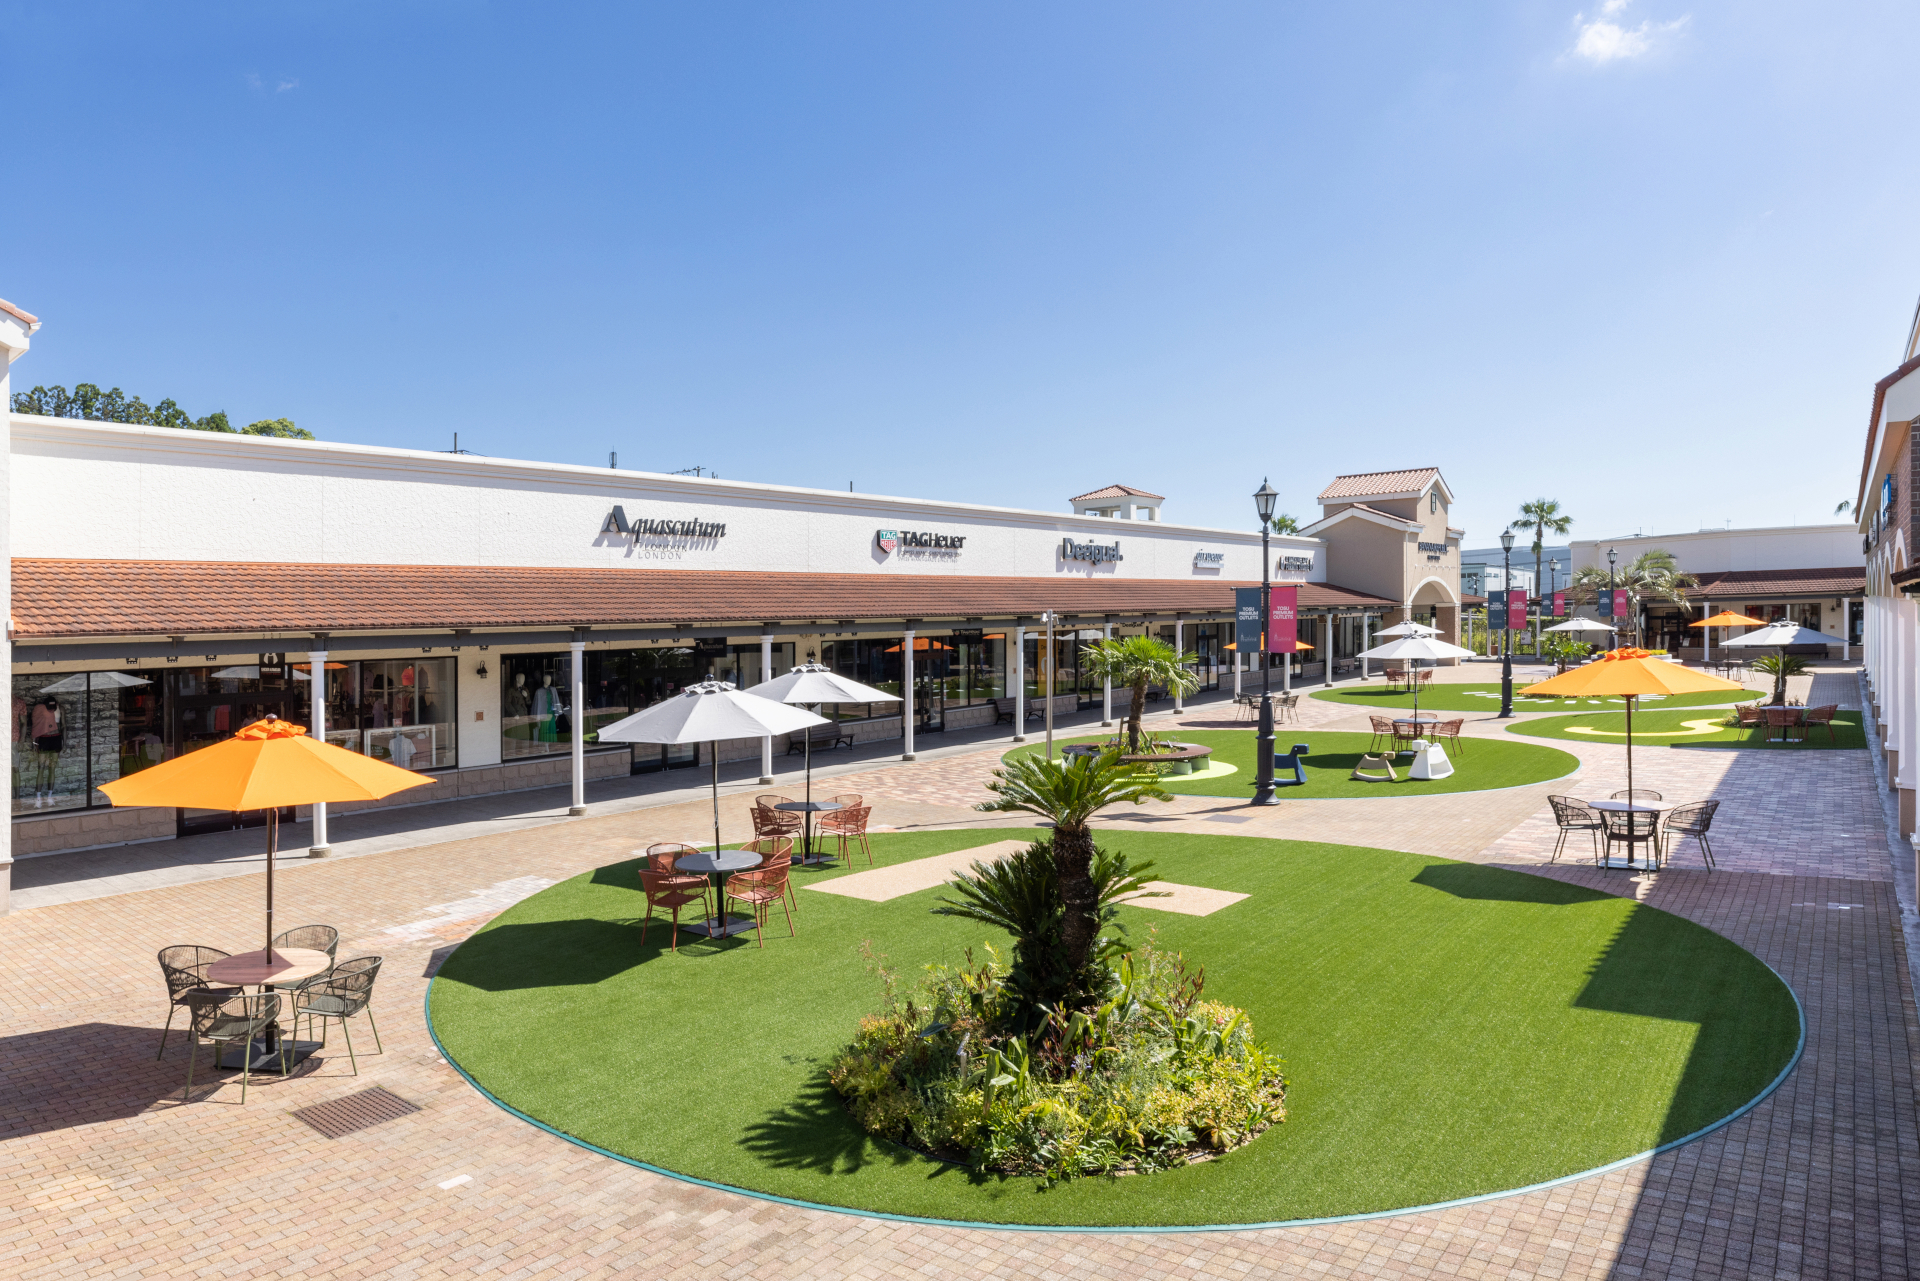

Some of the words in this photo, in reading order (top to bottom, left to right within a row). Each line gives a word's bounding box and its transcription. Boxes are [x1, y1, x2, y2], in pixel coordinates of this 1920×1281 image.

[601, 505, 726, 543] Aquascutum
[881, 531, 896, 540] TAG
[644, 543, 687, 552] LONDON
[880, 540, 897, 551] HEUER
